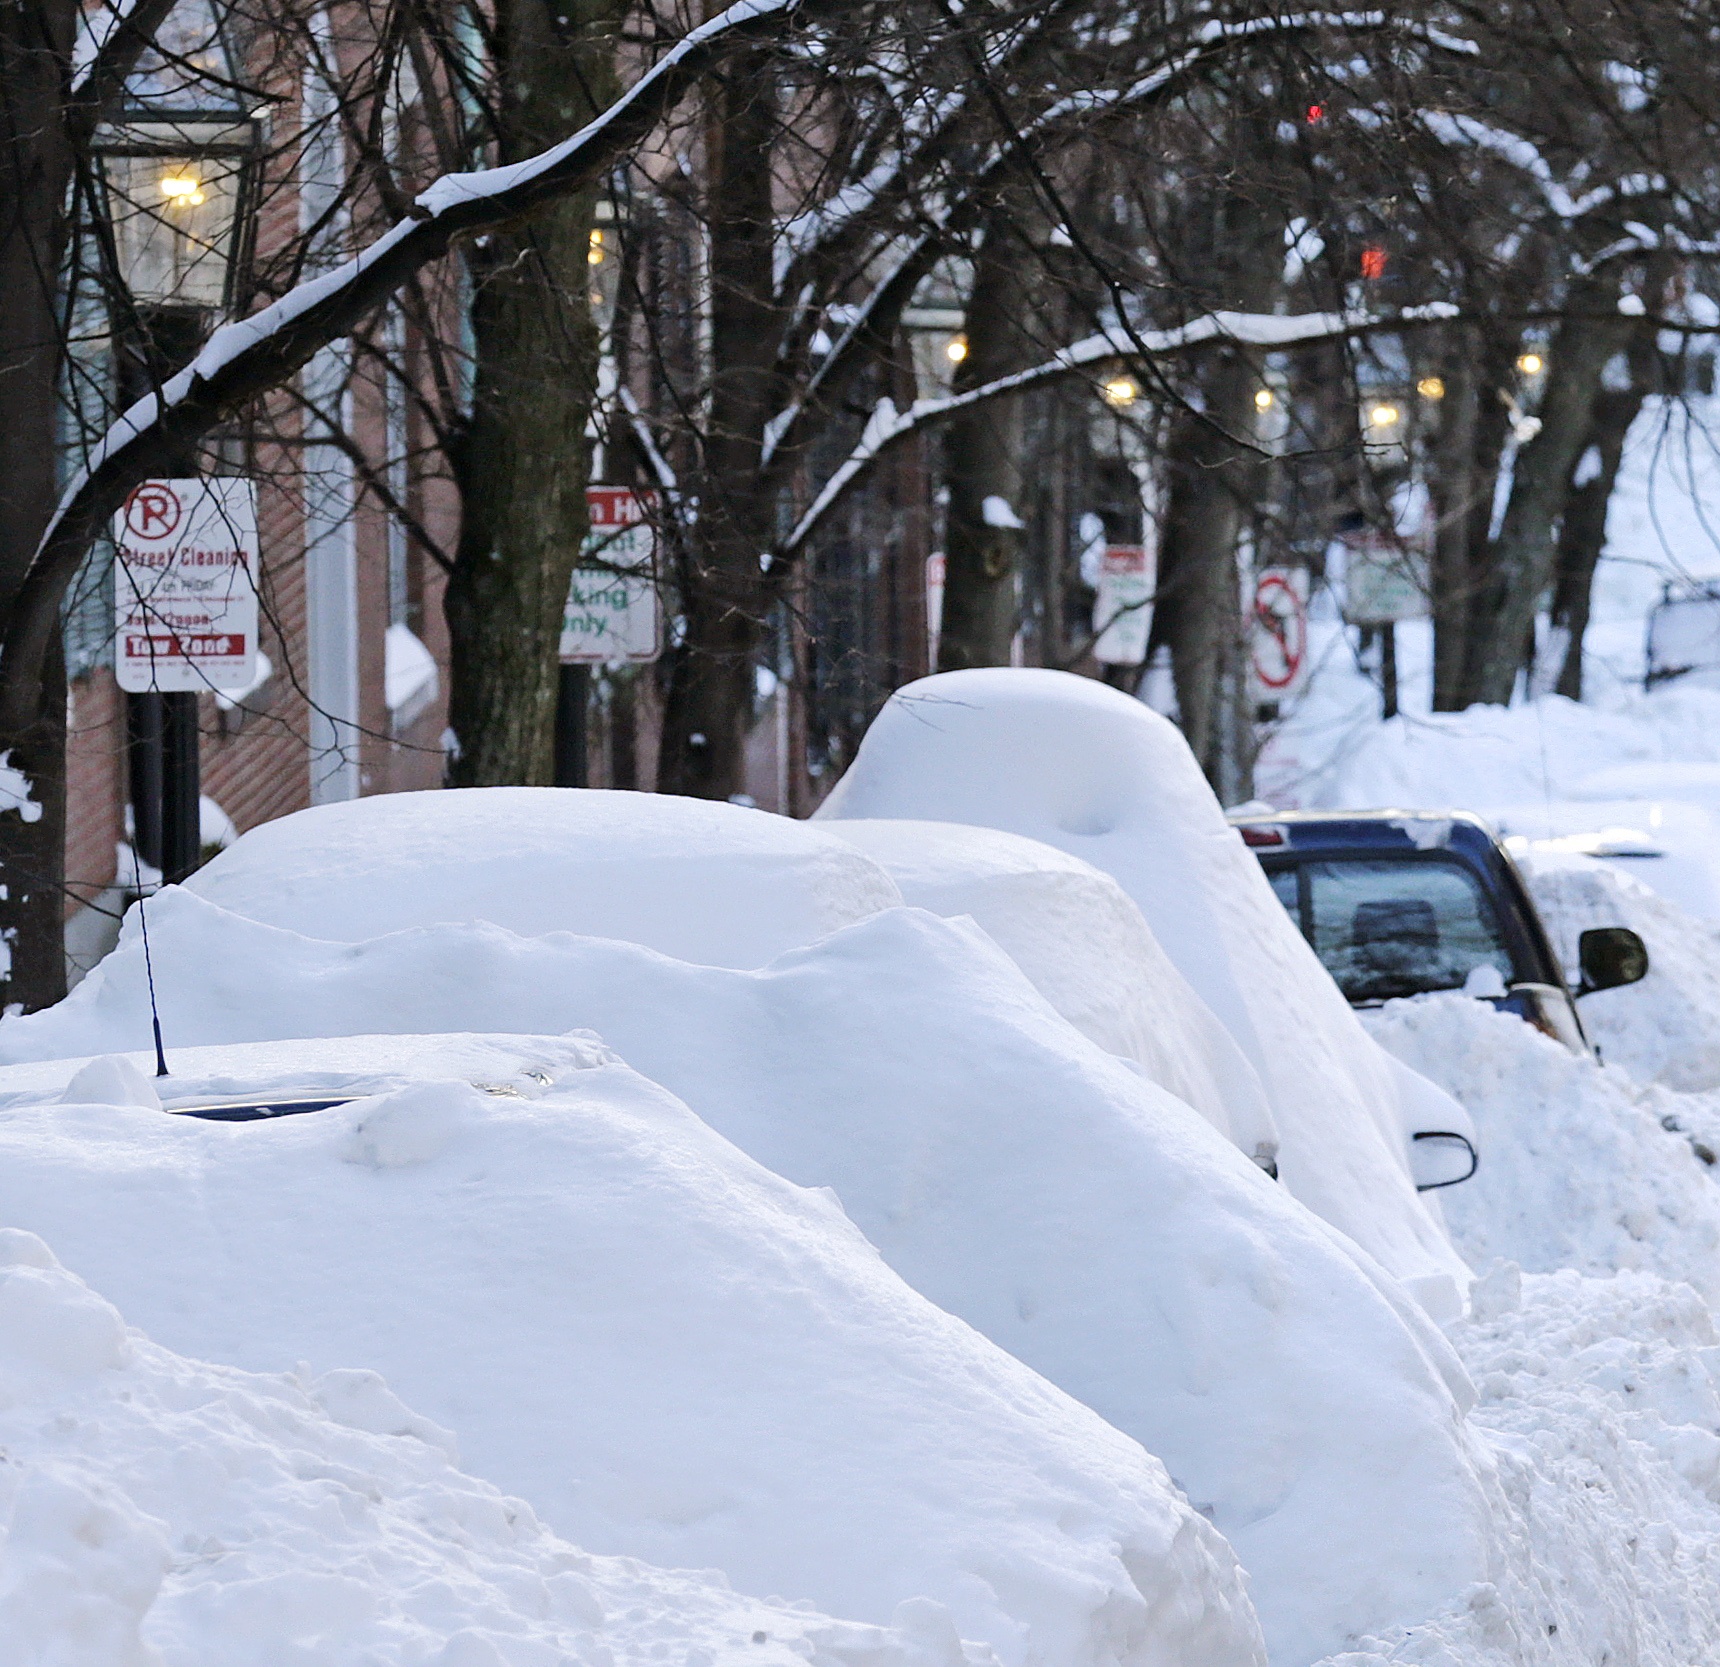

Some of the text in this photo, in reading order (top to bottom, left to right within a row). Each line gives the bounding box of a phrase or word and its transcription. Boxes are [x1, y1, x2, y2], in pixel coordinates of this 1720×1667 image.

[121, 547, 249, 569] Street Cleaning
[571, 584, 628, 610] king
[128, 635, 232, 655] Tow Zone
